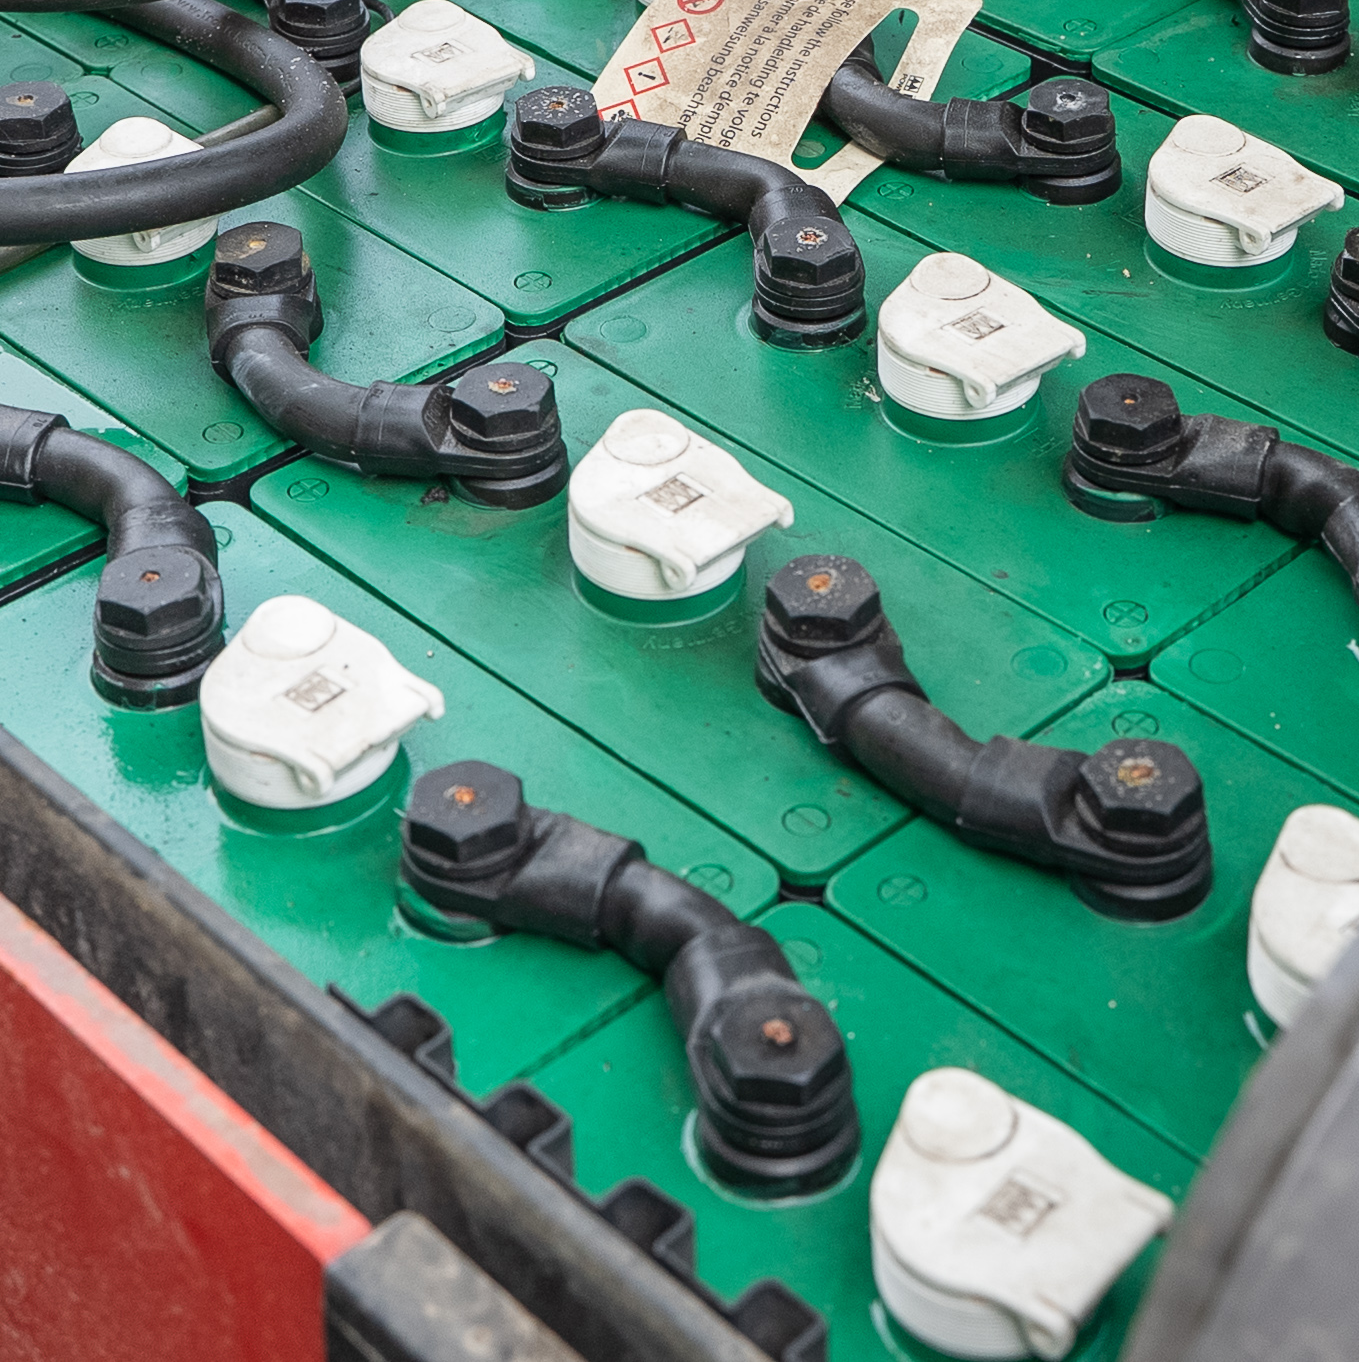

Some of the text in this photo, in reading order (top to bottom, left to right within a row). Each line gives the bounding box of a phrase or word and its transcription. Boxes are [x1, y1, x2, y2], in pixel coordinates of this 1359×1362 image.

[802, 5, 821, 18] de
[815, 8, 849, 38] follow
[753, 35, 772, 46] la
[762, 25, 777, 34] à
[749, 18, 812, 89] handleiding
[799, 38, 822, 57] the
[726, 47, 758, 88] notice
[742, 91, 760, 106] te
[751, 59, 808, 139] instructions
[693, 90, 733, 144] d'emplo
[718, 109, 749, 148] volge
